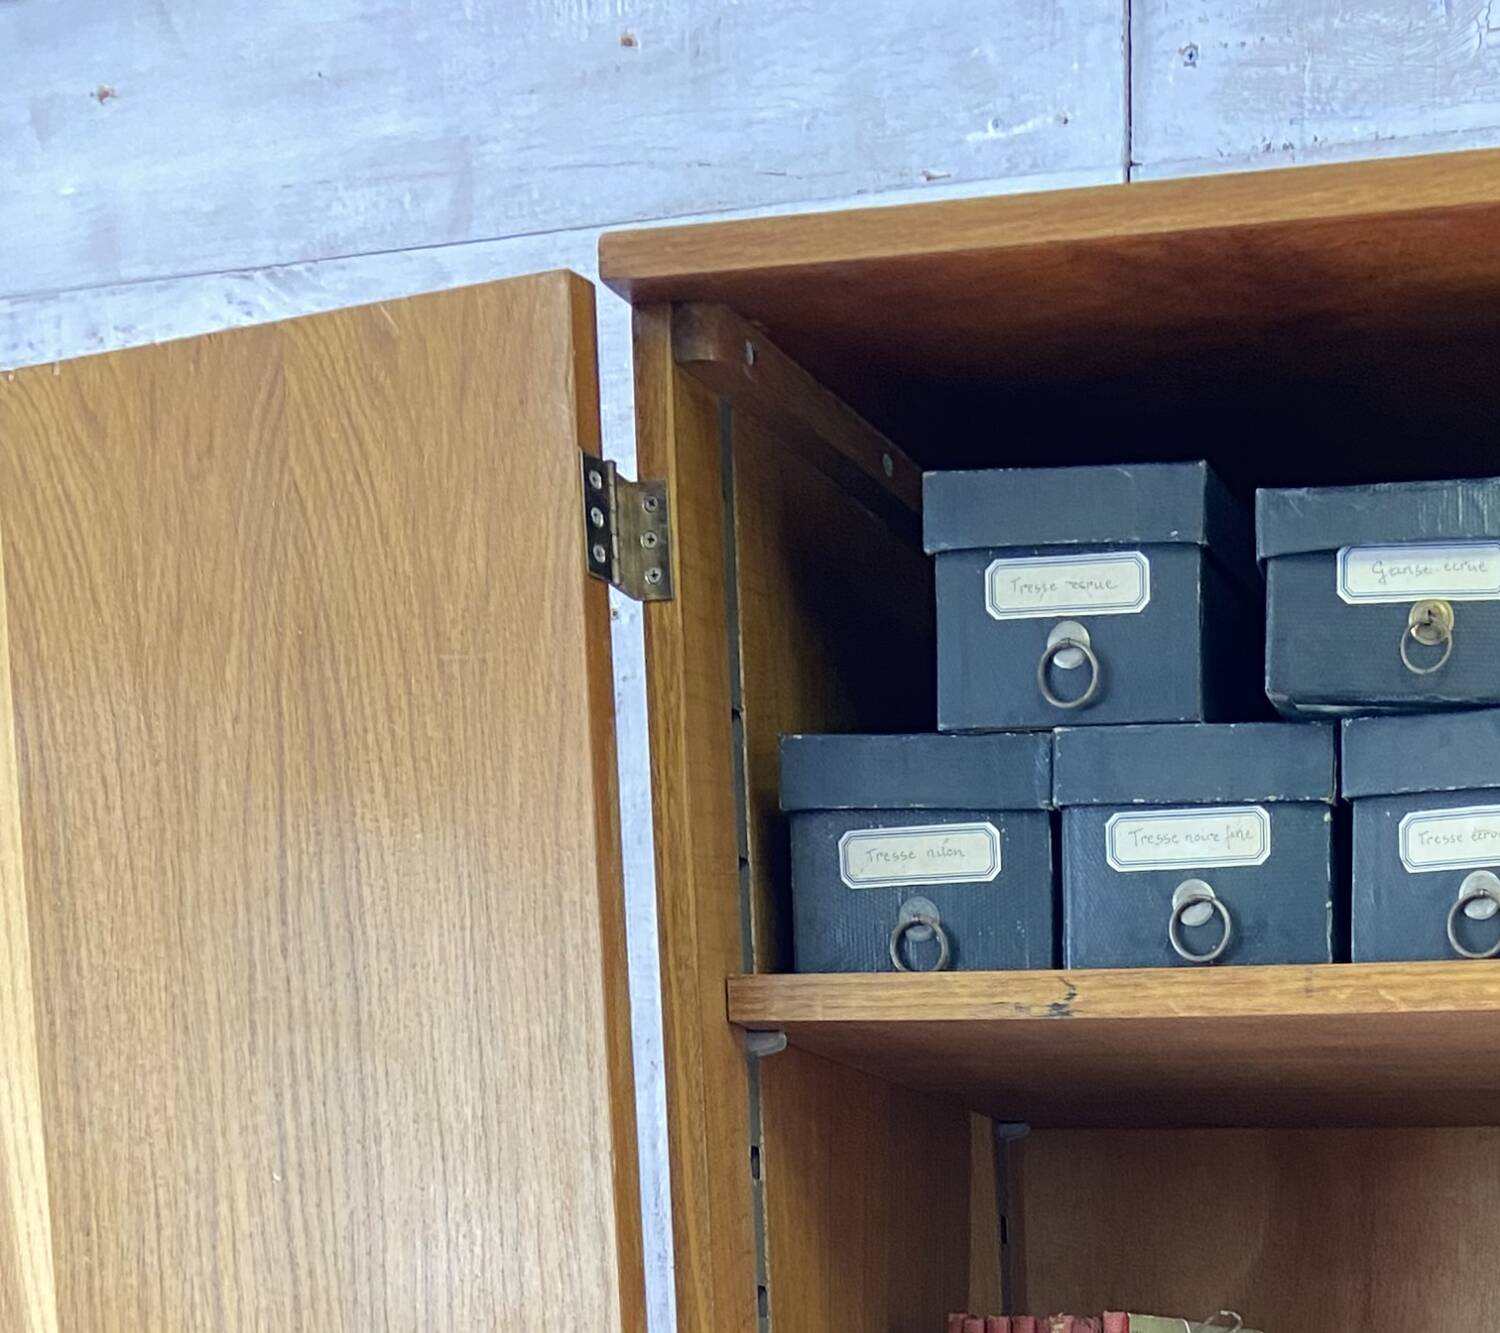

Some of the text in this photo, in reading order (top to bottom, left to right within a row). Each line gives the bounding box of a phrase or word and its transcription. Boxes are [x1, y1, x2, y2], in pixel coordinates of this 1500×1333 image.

[1010, 576, 1058, 599] Tresse
[1128, 827, 1179, 848] Tresse
[1418, 830, 1463, 846] Tresse
[866, 848, 917, 863] Tresse
